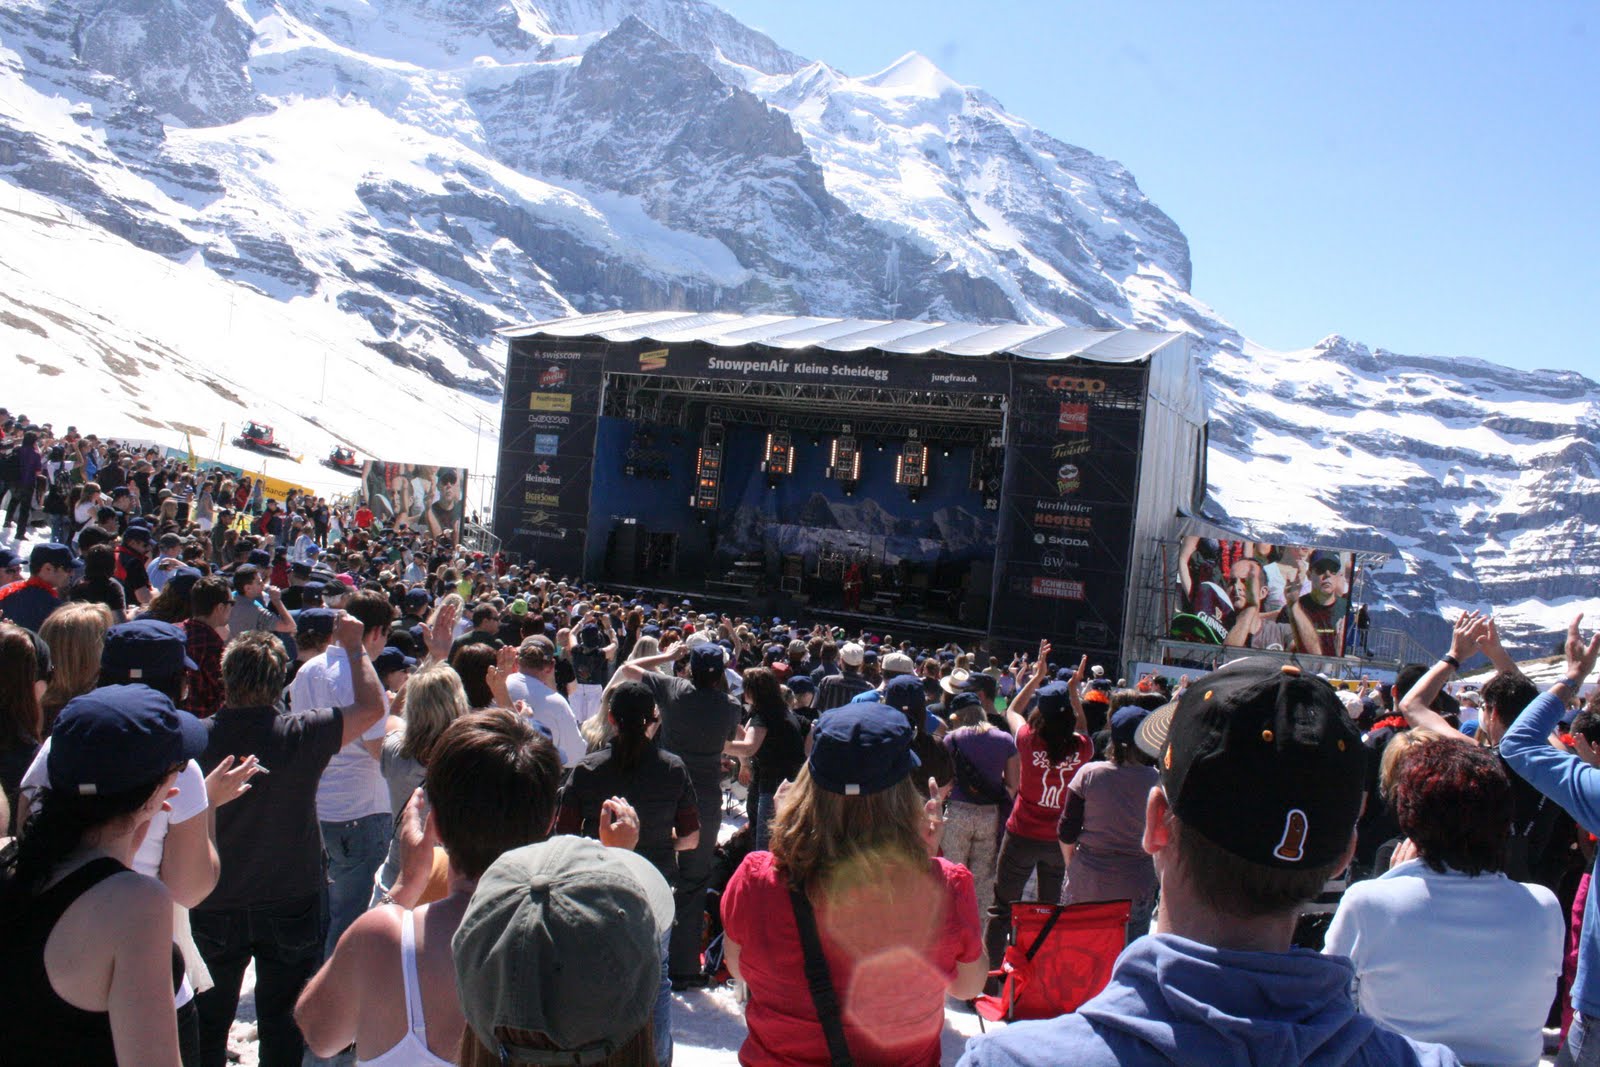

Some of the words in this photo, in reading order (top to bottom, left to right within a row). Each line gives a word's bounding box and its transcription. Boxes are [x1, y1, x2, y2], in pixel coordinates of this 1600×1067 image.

[542, 351, 581, 360] swisscom
[708, 356, 790, 374] SnowpenAir
[794, 363, 829, 375] Kleine
[831, 364, 889, 381] Scheidegg
[931, 372, 978, 383] jungfrau.ch
[525, 473, 561, 485] Heineken
[1036, 500, 1093, 513] kirchhofer
[1034, 513, 1092, 527] HOOTERS
[1043, 556, 1064, 568] BW
